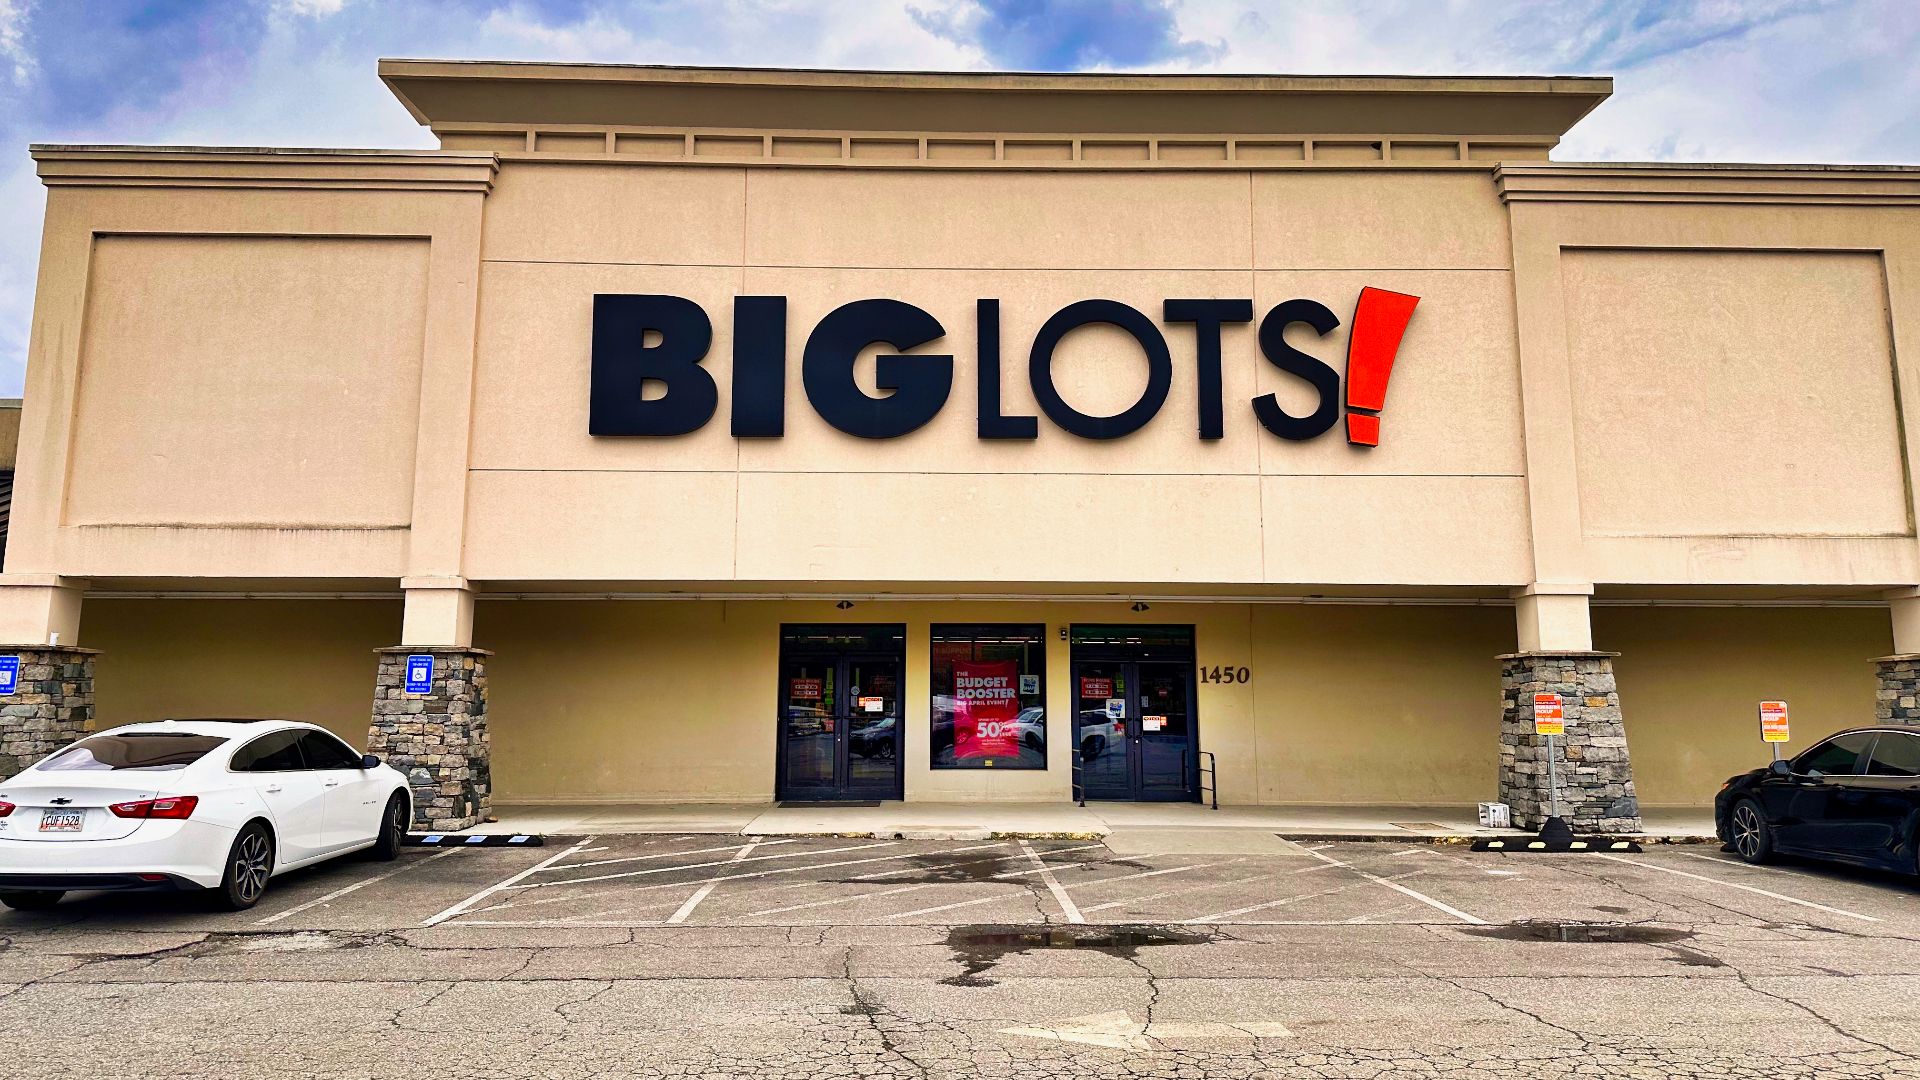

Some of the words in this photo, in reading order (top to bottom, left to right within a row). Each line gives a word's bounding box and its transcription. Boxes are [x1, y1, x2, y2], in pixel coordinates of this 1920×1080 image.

[588, 293, 954, 440] BIG
[976, 286, 1421, 448] LOTS!
[956, 676, 1008, 688] BUDGET
[1200, 665, 1249, 684] 1450
[956, 687, 1016, 699] BOOSTER
